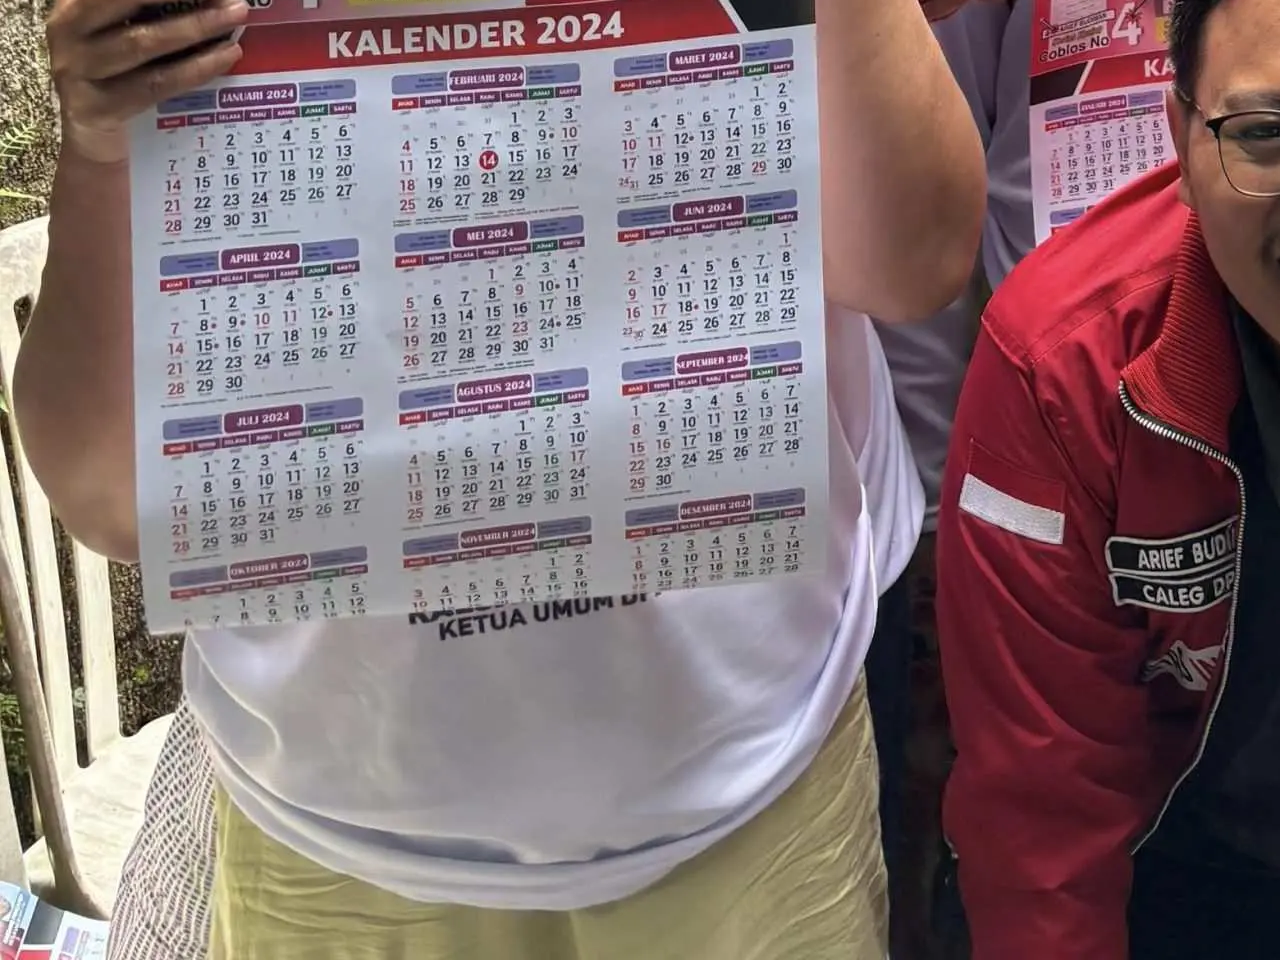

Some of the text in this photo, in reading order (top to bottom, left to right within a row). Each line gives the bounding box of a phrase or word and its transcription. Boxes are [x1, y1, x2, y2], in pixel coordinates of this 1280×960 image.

[1112, 2, 1143, 46] 4
[328, 10, 625, 59] KALENDER 2024
[1090, 35, 1110, 50] No
[675, 51, 735, 66] MARET 2024
[449, 71, 524, 86] FEBRUARI 2024
[221, 87, 294, 104] JANUARI 2024
[165, 165, 352, 192] 14 15 16 17 18 19 20
[684, 201, 733, 216] JUNI 2024
[466, 227, 514, 240] MEI 2024
[229, 251, 291, 265] APRIL 2024
[459, 380, 531, 396] AGUSTUS 2024
[236, 411, 290, 428] JULI 2024
[1138, 547, 1184, 571] ARIEF
[1143, 570, 1235, 607] CALEG DP
[439, 607, 527, 641] KETUA
[533, 595, 615, 622] UMUM
